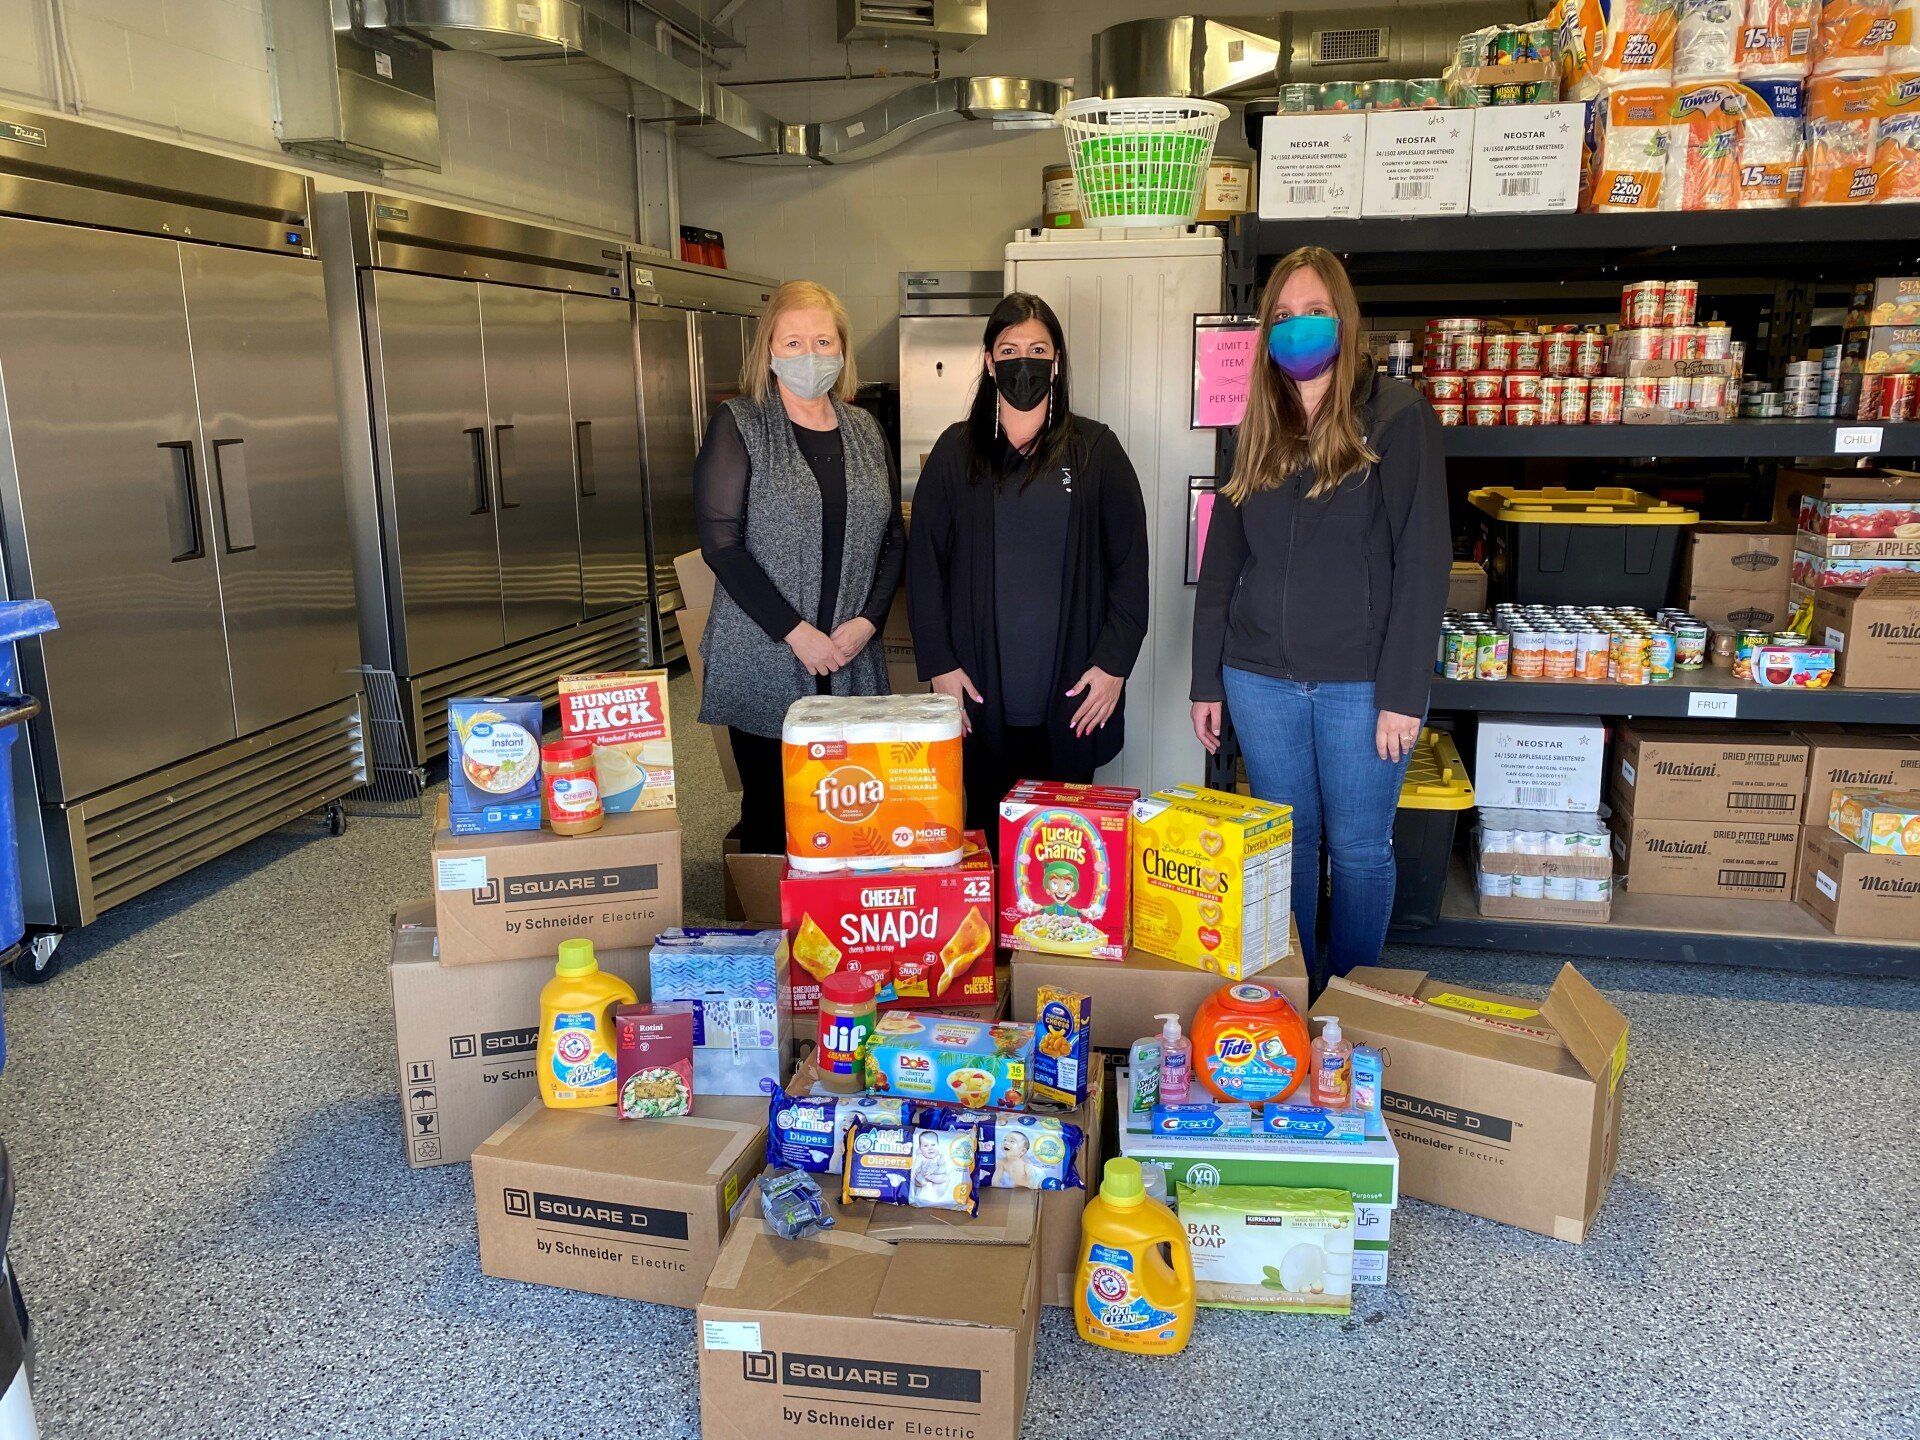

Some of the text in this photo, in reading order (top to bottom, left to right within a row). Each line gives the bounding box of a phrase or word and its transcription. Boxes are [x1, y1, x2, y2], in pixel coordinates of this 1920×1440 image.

[1745, 28, 1767, 49] 15
[1623, 43, 1657, 55] 2200
[1622, 55, 1653, 64] SHEETS
[1679, 90, 1721, 112] Towels
[1504, 131, 1545, 139] NEOSTAR
[1741, 166, 1765, 186] 15
[1854, 167, 1872, 177] OVER
[1615, 175, 1634, 183] OVER
[1852, 174, 1878, 189] 2200
[1612, 183, 1642, 195] 2200
[1849, 187, 1875, 198] SHEETS
[1609, 195, 1638, 203] SHEETS
[1217, 342, 1243, 351] LIMIT
[1221, 358, 1244, 367] ITEM
[1209, 395, 1226, 404] PER
[1844, 435, 1873, 444] CHILI
[1743, 636, 1769, 646] MISSION
[1769, 655, 1790, 665] Dole
[569, 687, 648, 710] HUNGRY
[1697, 701, 1728, 709] FRUIT
[570, 701, 655, 733] JACK
[492, 739, 524, 747] Instant
[597, 730, 661, 744] Mashed Potatoes
[815, 746, 821, 755] 6
[1516, 740, 1563, 749] NEOSTAR
[1518, 753, 1552, 761] APPLESAUCE
[1553, 754, 1585, 762] SWEETENED
[1723, 752, 1804, 762] DRIED PITTED PLUMS
[1653, 762, 1717, 777] Mariani
[1828, 769, 1894, 784] Mariani
[563, 791, 592, 800] Creamy
[812, 777, 885, 812] fiora
[1201, 795, 1245, 810] Cheerios
[1176, 805, 1220, 821] Cheerios
[916, 829, 947, 837] MORE
[1041, 826, 1083, 849] Lucky
[1713, 831, 1794, 841] DRIED PITTED PLUMS
[1162, 843, 1211, 862] Limited Edition
[1645, 839, 1707, 854] Mariani
[1034, 843, 1086, 865] Charms
[509, 874, 620, 895] SQUARE D
[963, 882, 991, 896] 42
[1157, 881, 1175, 890] HAPPY
[1176, 885, 1195, 895] HEART
[1196, 890, 1218, 901] SHAPES
[506, 909, 655, 934] by Schneider Electric
[926, 954, 935, 962] 21
[849, 962, 859, 971] 21
[972, 977, 993, 985] DOUBLE
[793, 985, 819, 993] CHEDDAR
[964, 983, 994, 994] CHEESE
[639, 1023, 663, 1032] Rotini
[486, 1034, 539, 1049] SQUA
[823, 1025, 867, 1051] Jif
[454, 1038, 472, 1056] D
[1220, 1038, 1252, 1059] Tide
[900, 1055, 929, 1071] Dole
[1166, 1055, 1185, 1064] Suave
[1324, 1059, 1344, 1068] Suave
[575, 1064, 595, 1075] OXI
[1010, 1066, 1022, 1074] 16
[1223, 1067, 1246, 1075] PODS
[483, 1074, 498, 1083] by
[568, 1070, 599, 1087] CLEAN
[1139, 1074, 1159, 1089] SPEED
[1141, 1082, 1158, 1094] STICK
[789, 1104, 824, 1120] Angel
[1384, 1095, 1481, 1128] SQUARE D
[800, 1119, 833, 1132] mine
[1162, 1118, 1215, 1130] Crest
[1272, 1117, 1326, 1131] Crest
[789, 1132, 828, 1144] Diapers
[868, 1128, 903, 1143] Angel
[878, 1143, 912, 1154] mine
[1394, 1129, 1454, 1151] Schneider
[1458, 1147, 1505, 1166] Electric
[868, 1157, 906, 1166] Diapers
[960, 1186, 966, 1195] 3
[539, 1200, 648, 1227] SQUARE D
[1188, 1223, 1221, 1235] BAR
[537, 1238, 686, 1272] by Schneider Electric
[1110, 1305, 1131, 1315] OXI
[1102, 1312, 1137, 1324] CLEAN
[788, 1362, 930, 1388] SQUARE D
[783, 1407, 975, 1439] by Schneider Electric
